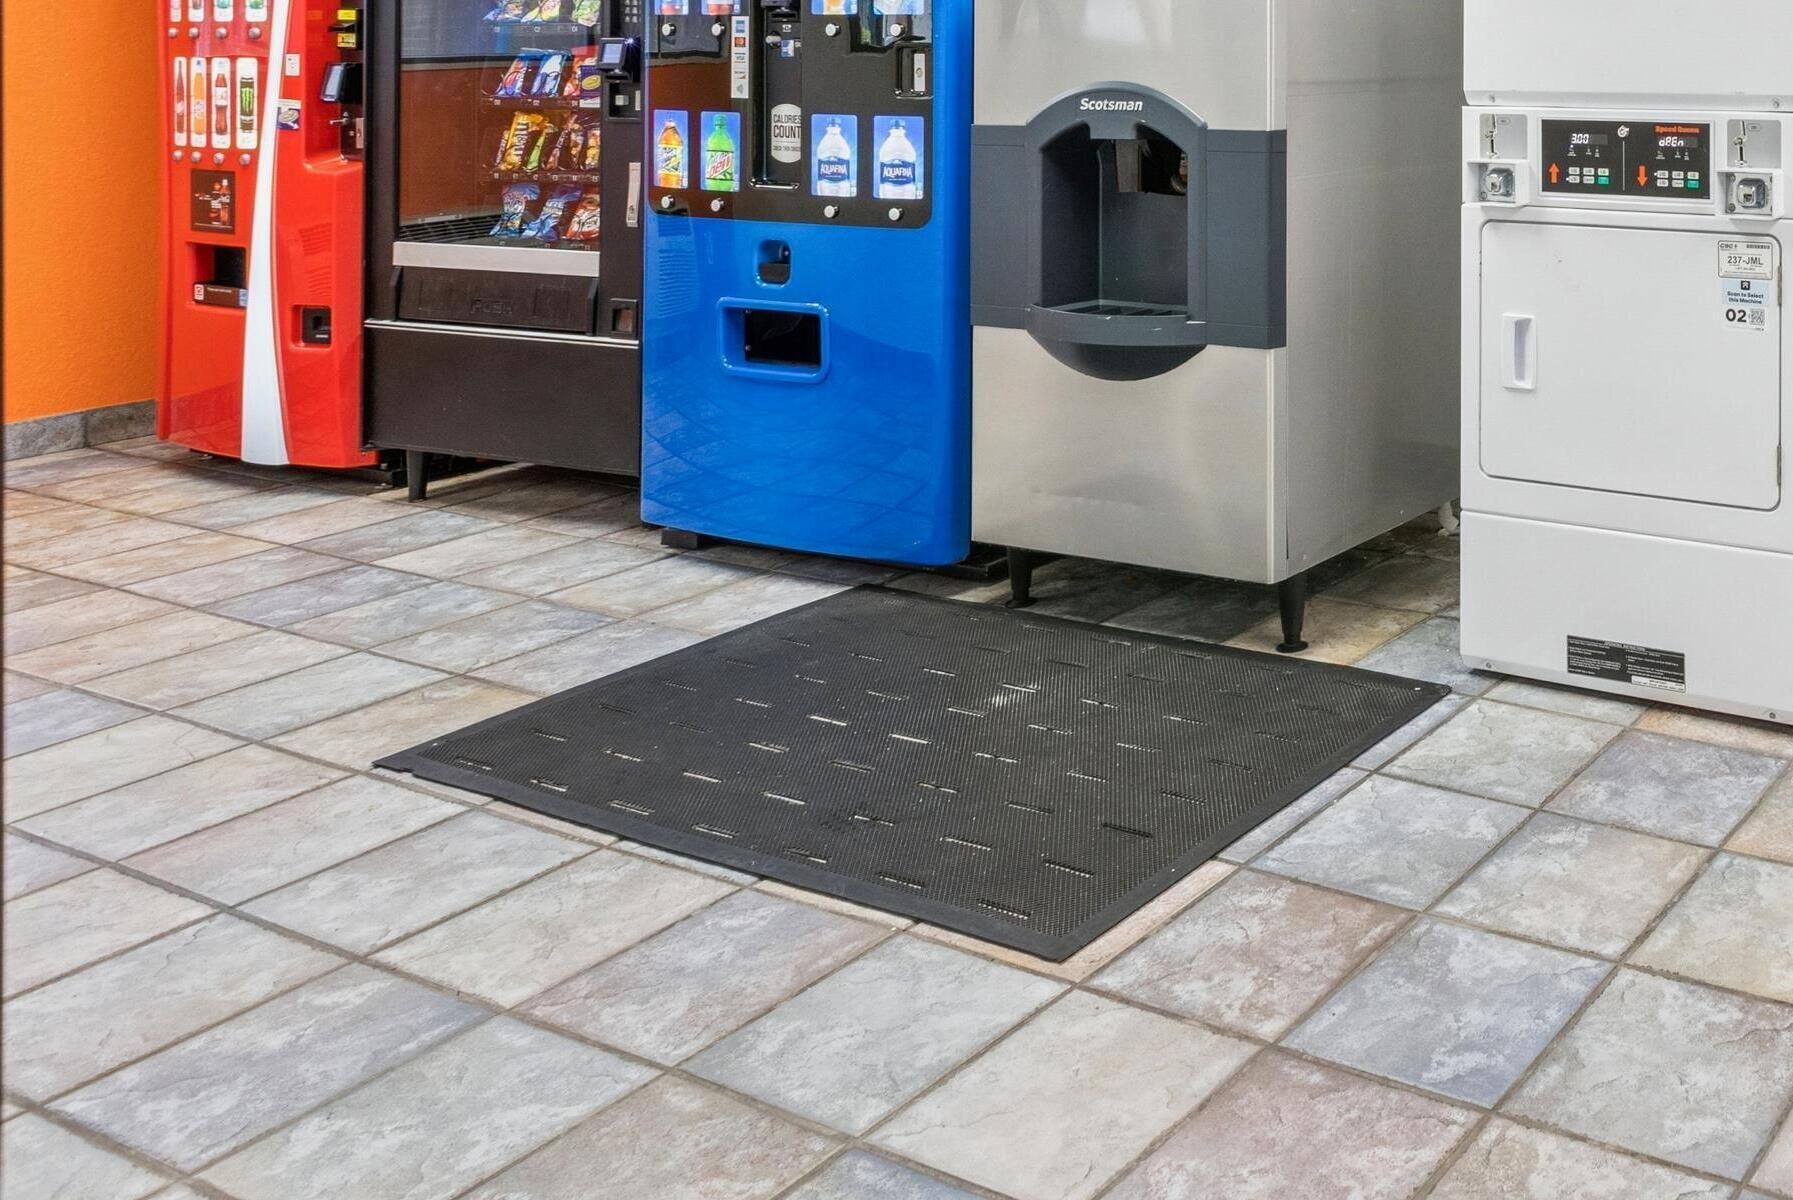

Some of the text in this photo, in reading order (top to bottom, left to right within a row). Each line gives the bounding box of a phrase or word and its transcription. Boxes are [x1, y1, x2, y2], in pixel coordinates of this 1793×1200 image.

[1080, 98, 1143, 111] Scotsman
[773, 114, 801, 124] CALORIES
[773, 125, 800, 139] COUNT
[820, 164, 848, 175] AQUAFINA
[882, 167, 913, 178] AQUAFINA
[1727, 255, 1764, 266] 237-JML
[1725, 308, 1747, 323] 02
